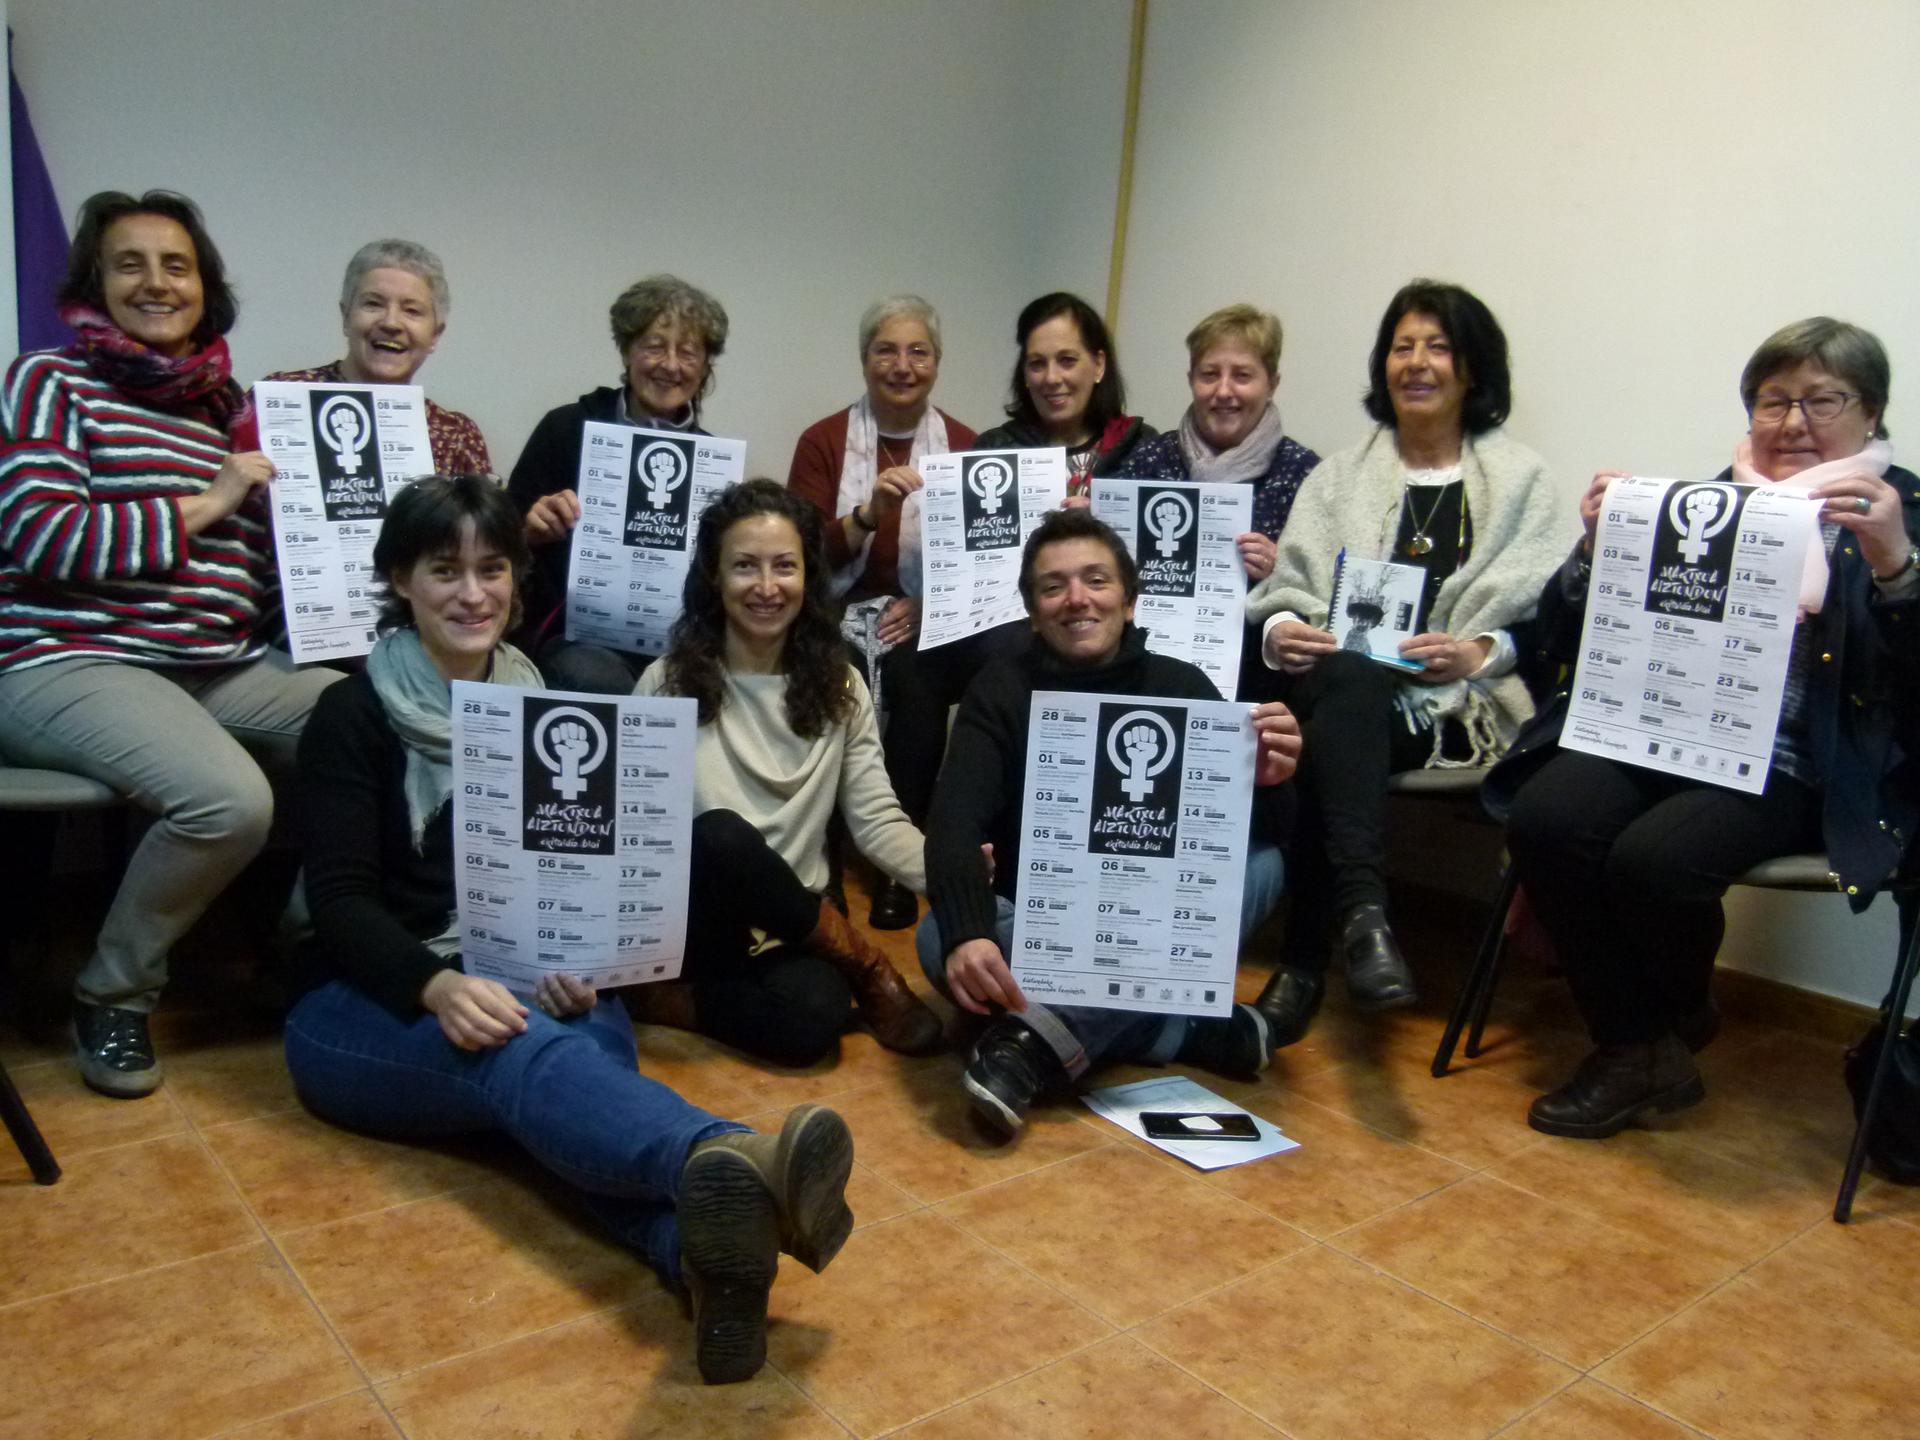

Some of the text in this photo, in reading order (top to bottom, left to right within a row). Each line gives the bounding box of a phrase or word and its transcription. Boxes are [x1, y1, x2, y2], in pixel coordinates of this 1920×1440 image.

[267, 400, 279, 408] 28
[1609, 513, 1620, 522] 01
[1742, 534, 1756, 543] 13
[1604, 549, 1617, 558] 03
[1736, 572, 1750, 581] 14
[1599, 585, 1612, 594] 05
[1731, 606, 1745, 615] 16
[1595, 616, 1608, 625] 06
[1655, 621, 1670, 630] 06
[1726, 640, 1739, 648] 17
[1589, 652, 1603, 661] 06
[1648, 663, 1662, 672] 07
[1717, 677, 1733, 686] 23
[1583, 691, 1596, 700] 06
[464, 704, 481, 713] 28
[1042, 711, 1058, 720] 28
[1711, 713, 1726, 723] 27
[623, 717, 641, 726] 08
[1191, 720, 1208, 729] 08
[464, 748, 478, 757] 01
[1039, 754, 1052, 763] 01
[624, 768, 639, 777] 13
[1188, 771, 1203, 780] 13
[465, 785, 482, 795] 03
[1036, 792, 1052, 801] 03
[624, 805, 638, 813] 14
[1185, 808, 1199, 816] 14
[466, 823, 482, 832] 05
[1034, 829, 1049, 838] 05
[623, 837, 638, 846] 16
[1183, 841, 1197, 849] 16
[467, 856, 483, 865] 06
[539, 859, 555, 868] 06
[1031, 862, 1047, 871] 06
[1102, 861, 1118, 870] 06
[622, 869, 636, 877] 17
[1180, 874, 1193, 882] 17
[468, 891, 484, 901] 06
[538, 901, 554, 910] 07
[619, 904, 635, 912] 23
[1028, 900, 1044, 908] 06
[1098, 904, 1113, 912] 07
[1174, 910, 1190, 919] 23
[471, 929, 486, 939] 06
[538, 930, 555, 939] 08
[1096, 934, 1112, 943] 08
[618, 938, 633, 946] 27
[1025, 941, 1041, 949] 06
[1171, 947, 1186, 955] 27
